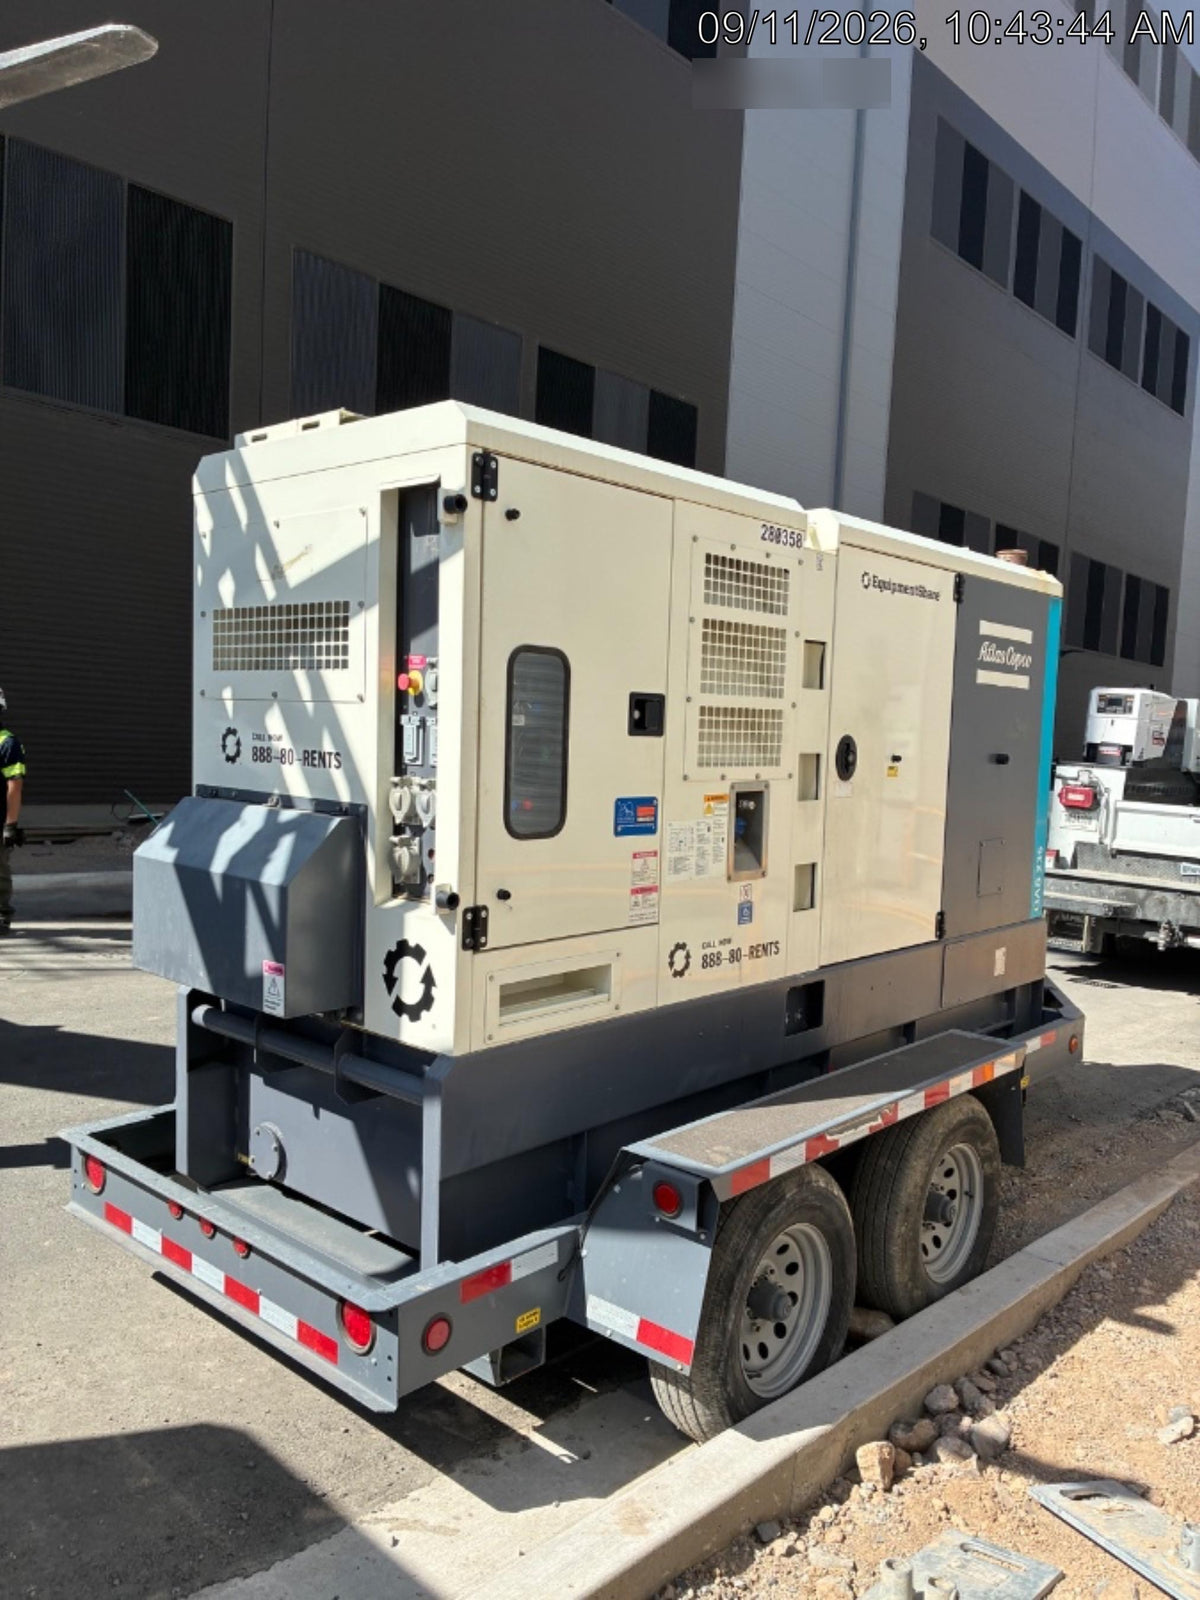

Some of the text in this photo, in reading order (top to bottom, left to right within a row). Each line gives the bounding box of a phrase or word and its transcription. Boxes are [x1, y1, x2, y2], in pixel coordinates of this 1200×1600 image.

[761, 523, 803, 549] 280358
[872, 574, 940, 601] EquipmentShare
[978, 641, 1032, 671] Atlas Copco
[251, 745, 342, 769] 888-80-RENTS
[701, 940, 780, 970] 888-80-RENTS
[702, 941, 717, 950] CALL
